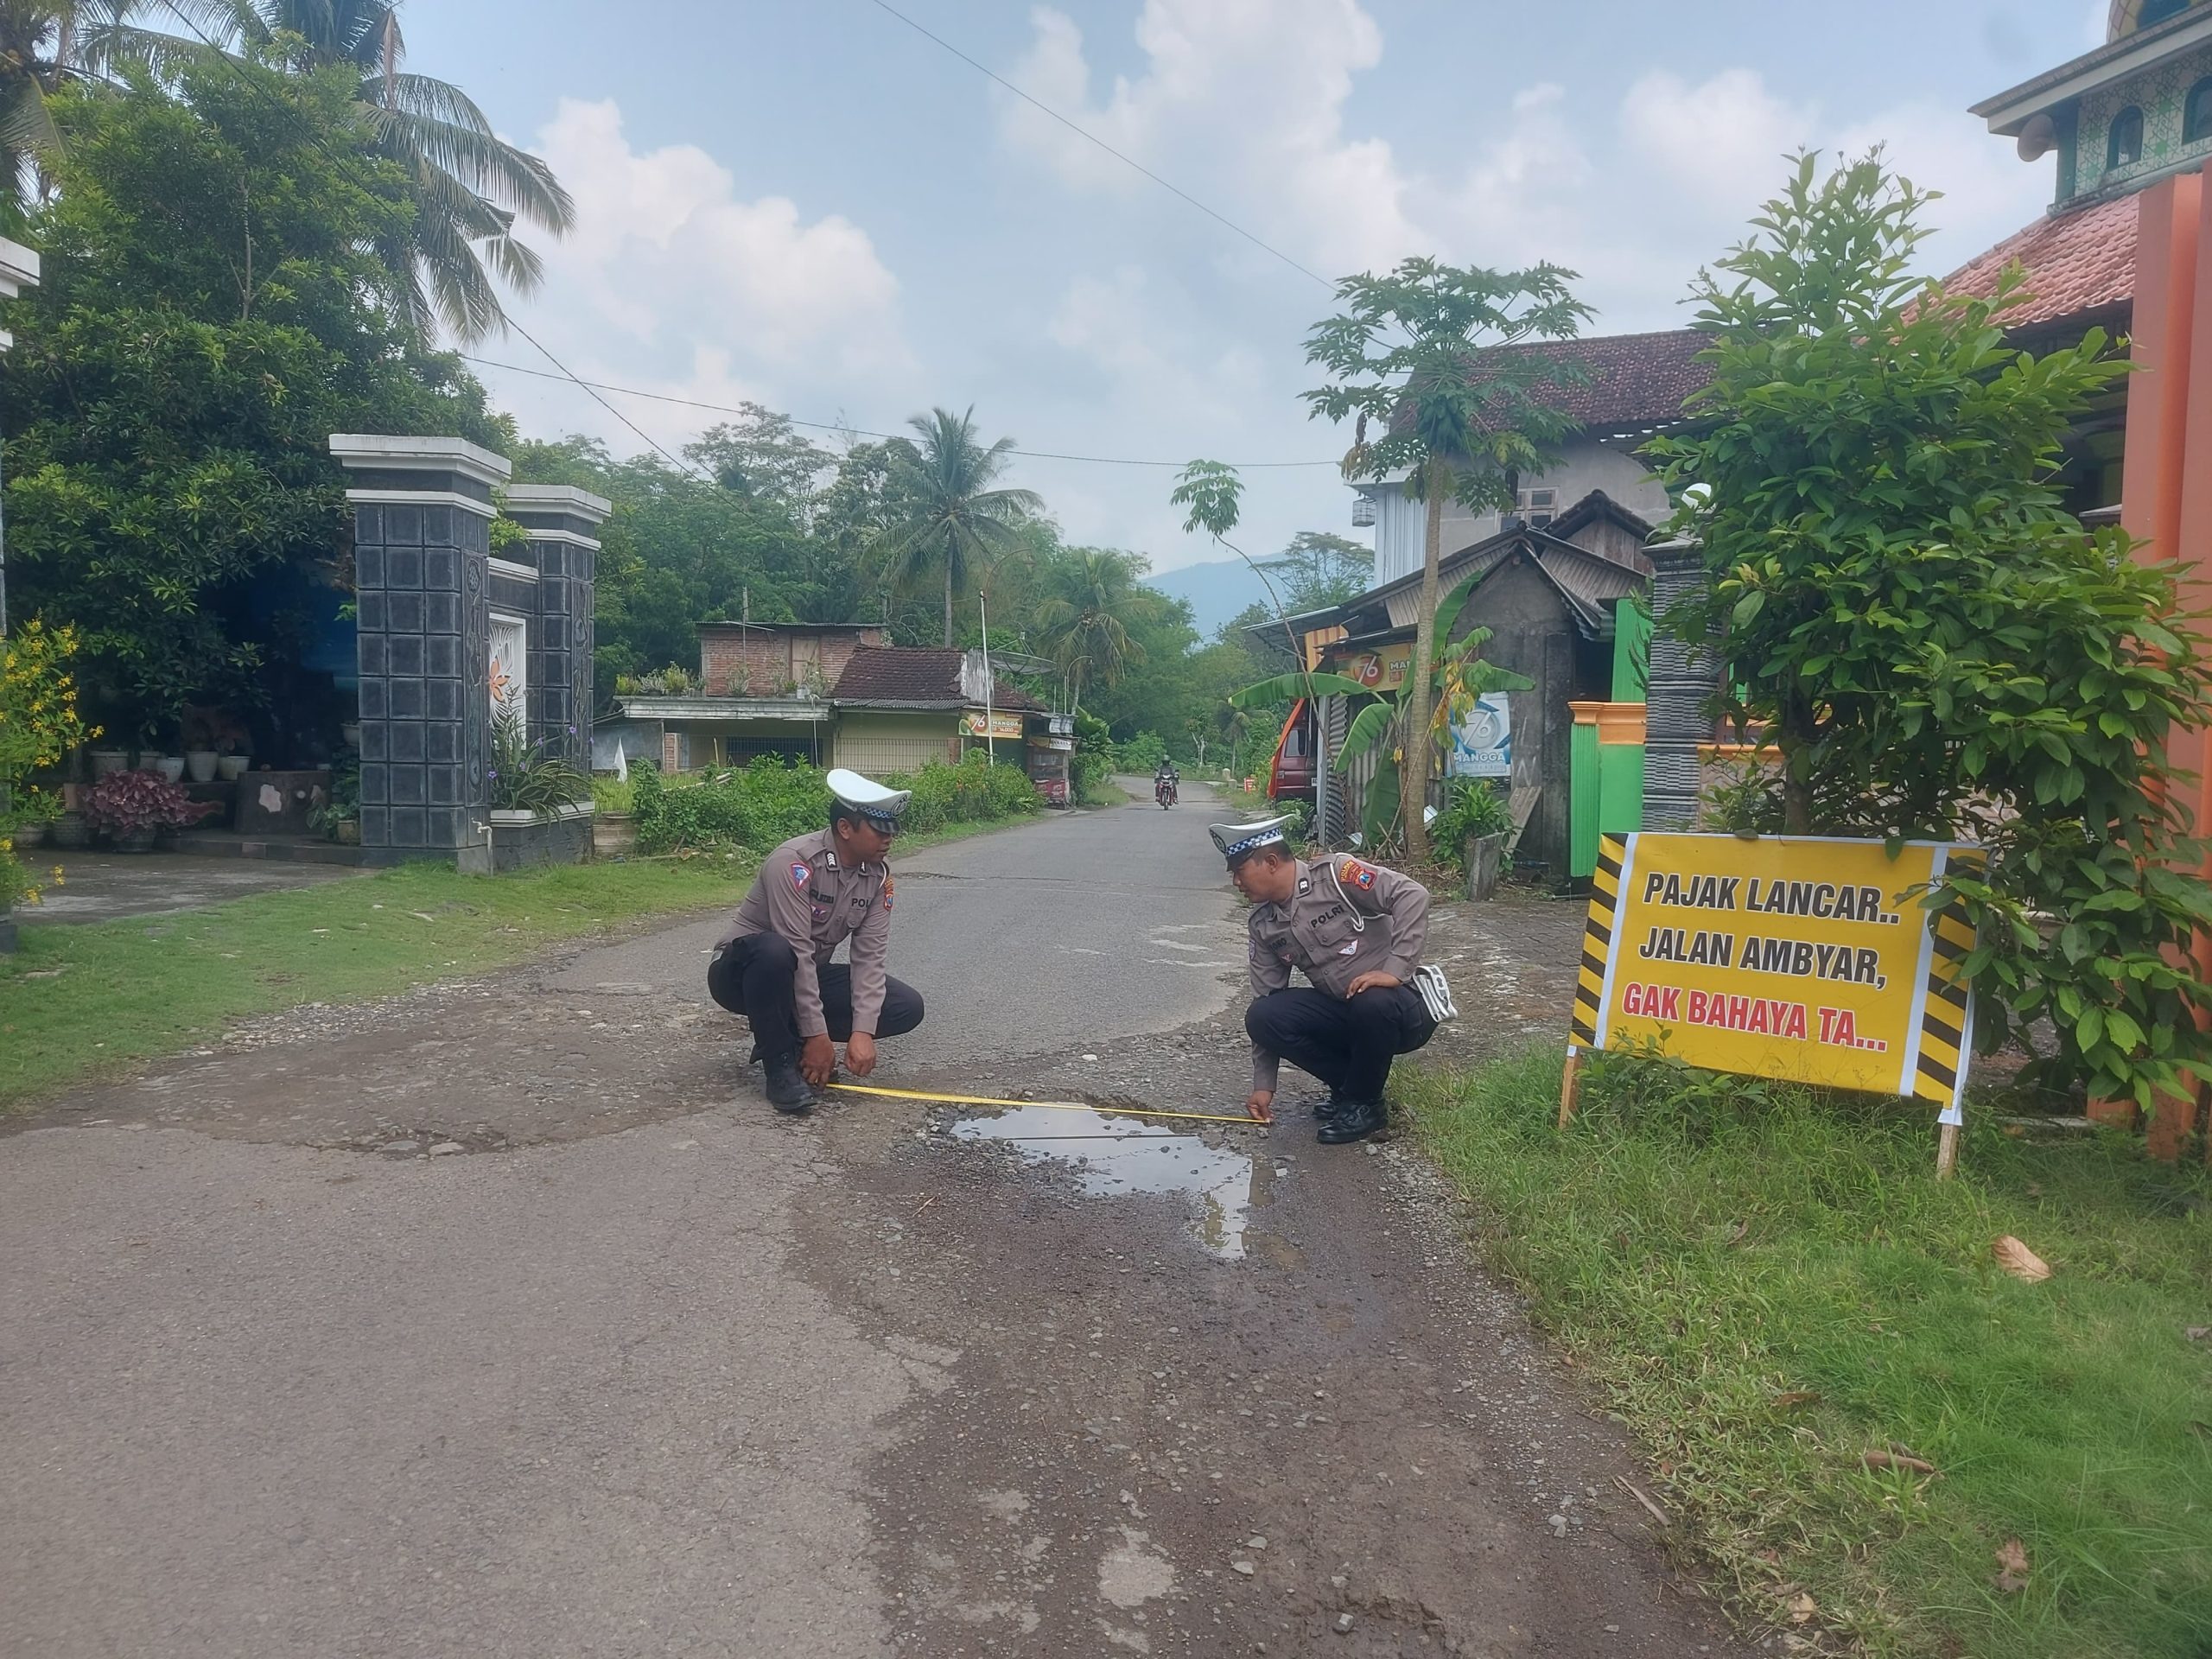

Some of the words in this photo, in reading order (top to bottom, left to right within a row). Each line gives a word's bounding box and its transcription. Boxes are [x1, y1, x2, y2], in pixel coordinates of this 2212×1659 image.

[1357, 656, 1379, 683] 76
[971, 714, 985, 731] 76
[1453, 753, 1505, 762] MANGGA
[1643, 872, 1741, 911] PAJAK
[1745, 877, 1900, 925] LANCAR..
[1311, 905, 1344, 928] POLRI
[1638, 926, 1734, 969] JALAN
[1738, 935, 1887, 991] AMBYAR,
[1622, 982, 1682, 1022] GAK
[1687, 990, 1808, 1041] BAHAYA
[1816, 1007, 1888, 1053] TA...
